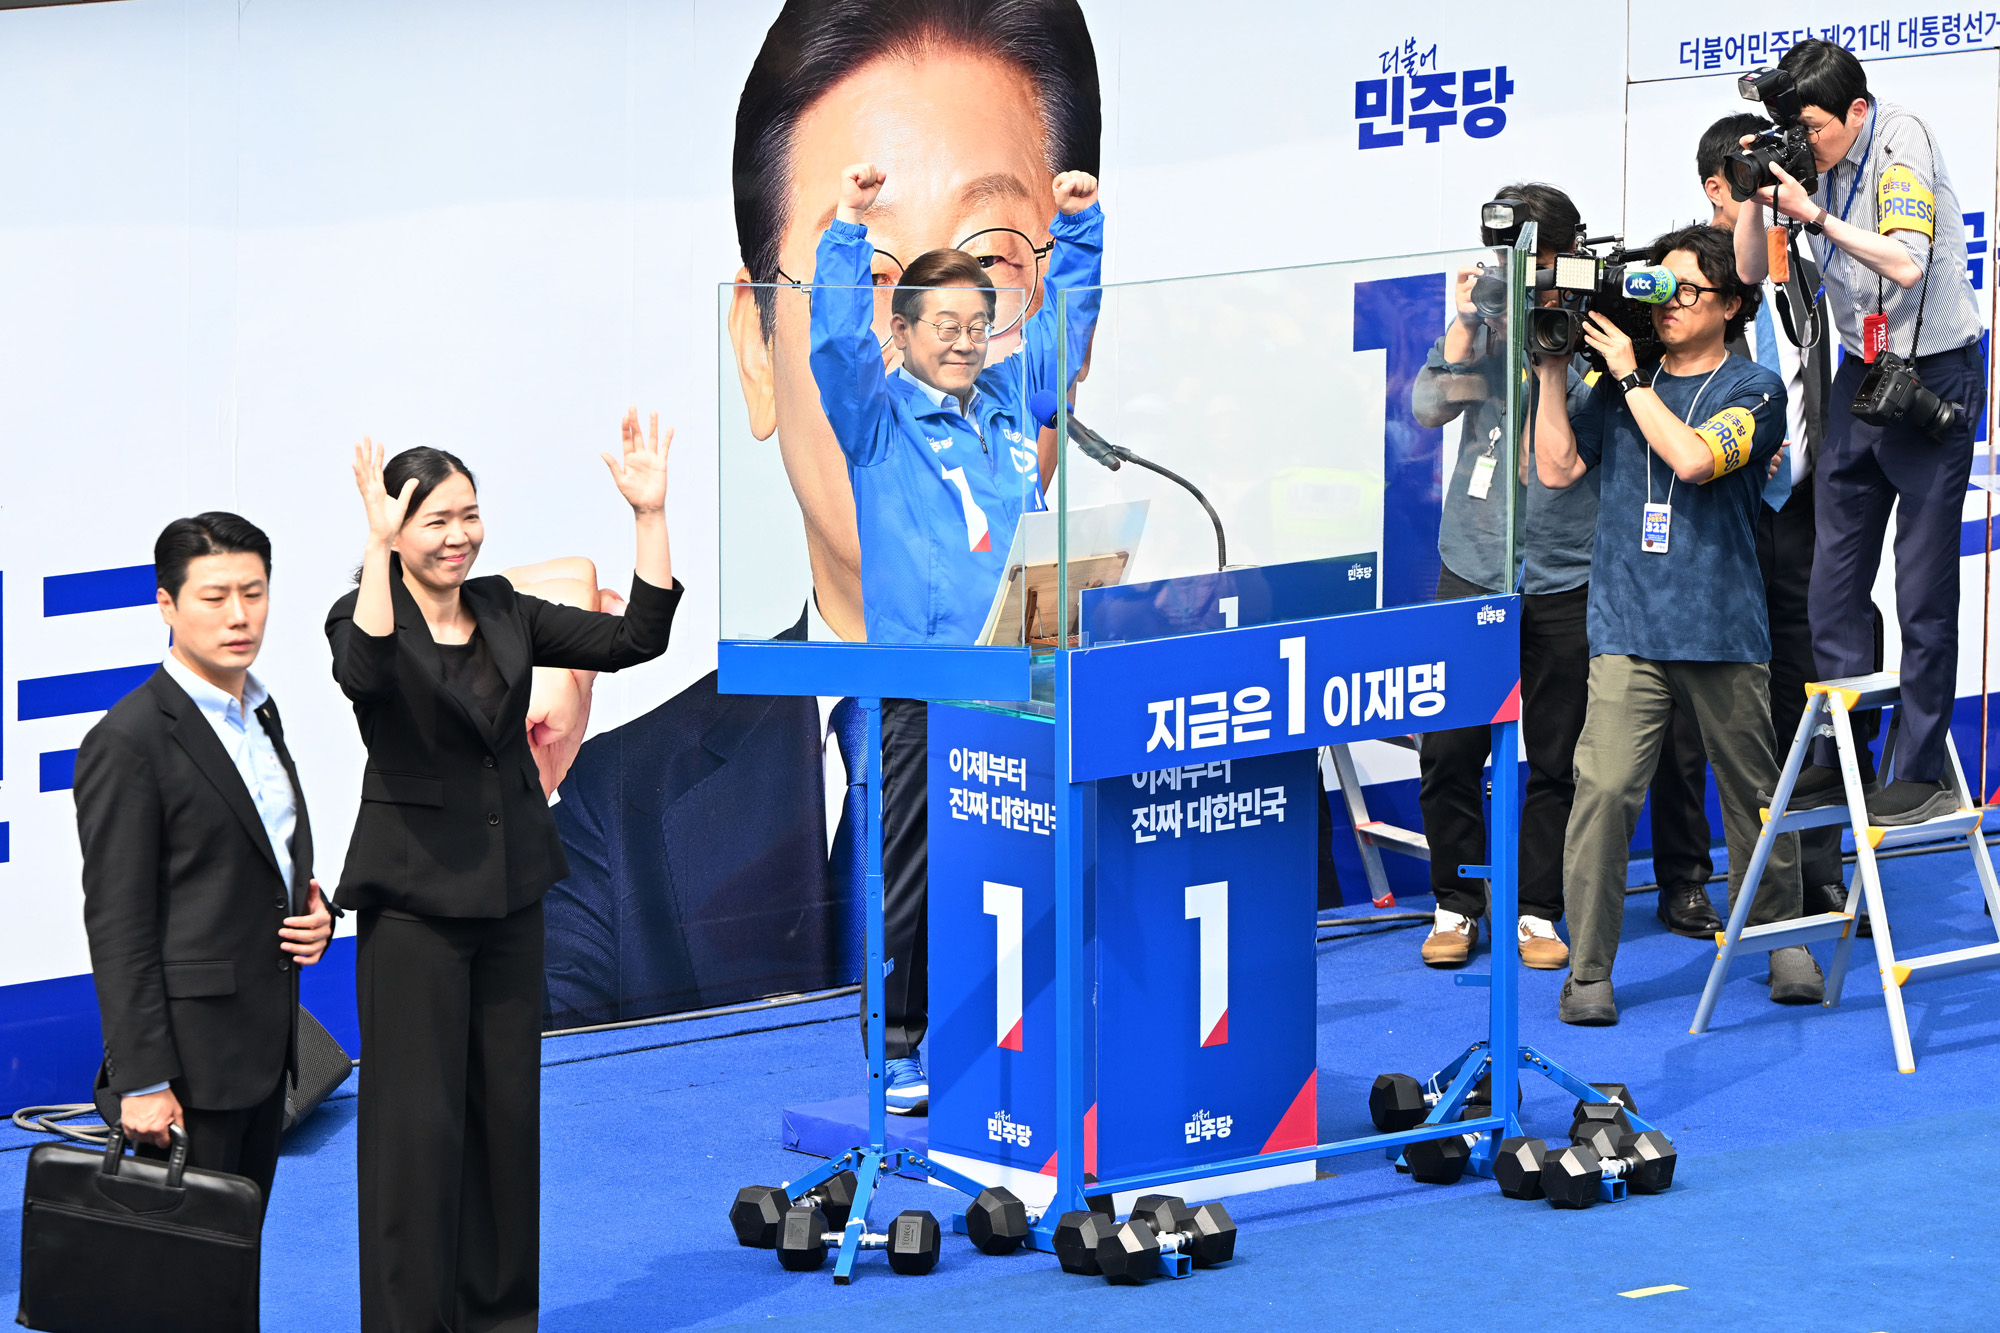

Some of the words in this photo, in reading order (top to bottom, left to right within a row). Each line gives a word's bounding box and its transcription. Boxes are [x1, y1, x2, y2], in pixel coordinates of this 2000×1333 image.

[1378, 36, 1437, 79] 더불어
[1355, 65, 1514, 150] 민주당
[1883, 181, 1911, 194] 민주당
[1884, 197, 1933, 223] PRESS
[1722, 412, 1747, 437] 민주당
[1707, 421, 1740, 472] PRESS
[1645, 522, 1667, 534] 323
[1348, 566, 1373, 581] 민주당
[1476, 608, 1506, 625] 민주당
[1146, 686, 1272, 753] 지금은
[1280, 636, 1306, 736] 1
[1323, 661, 1446, 727] 이재명
[949, 747, 1026, 791] 이제부터
[949, 787, 989, 825] 진짜
[991, 795, 1056, 836] 대한민
[1131, 800, 1183, 844] 진짜
[1187, 785, 1287, 834] 대한민국
[983, 880, 1023, 1052] 1
[1185, 880, 1228, 1048] 1
[987, 1117, 1032, 1147] 민주당
[1184, 1114, 1233, 1144] 민주당
